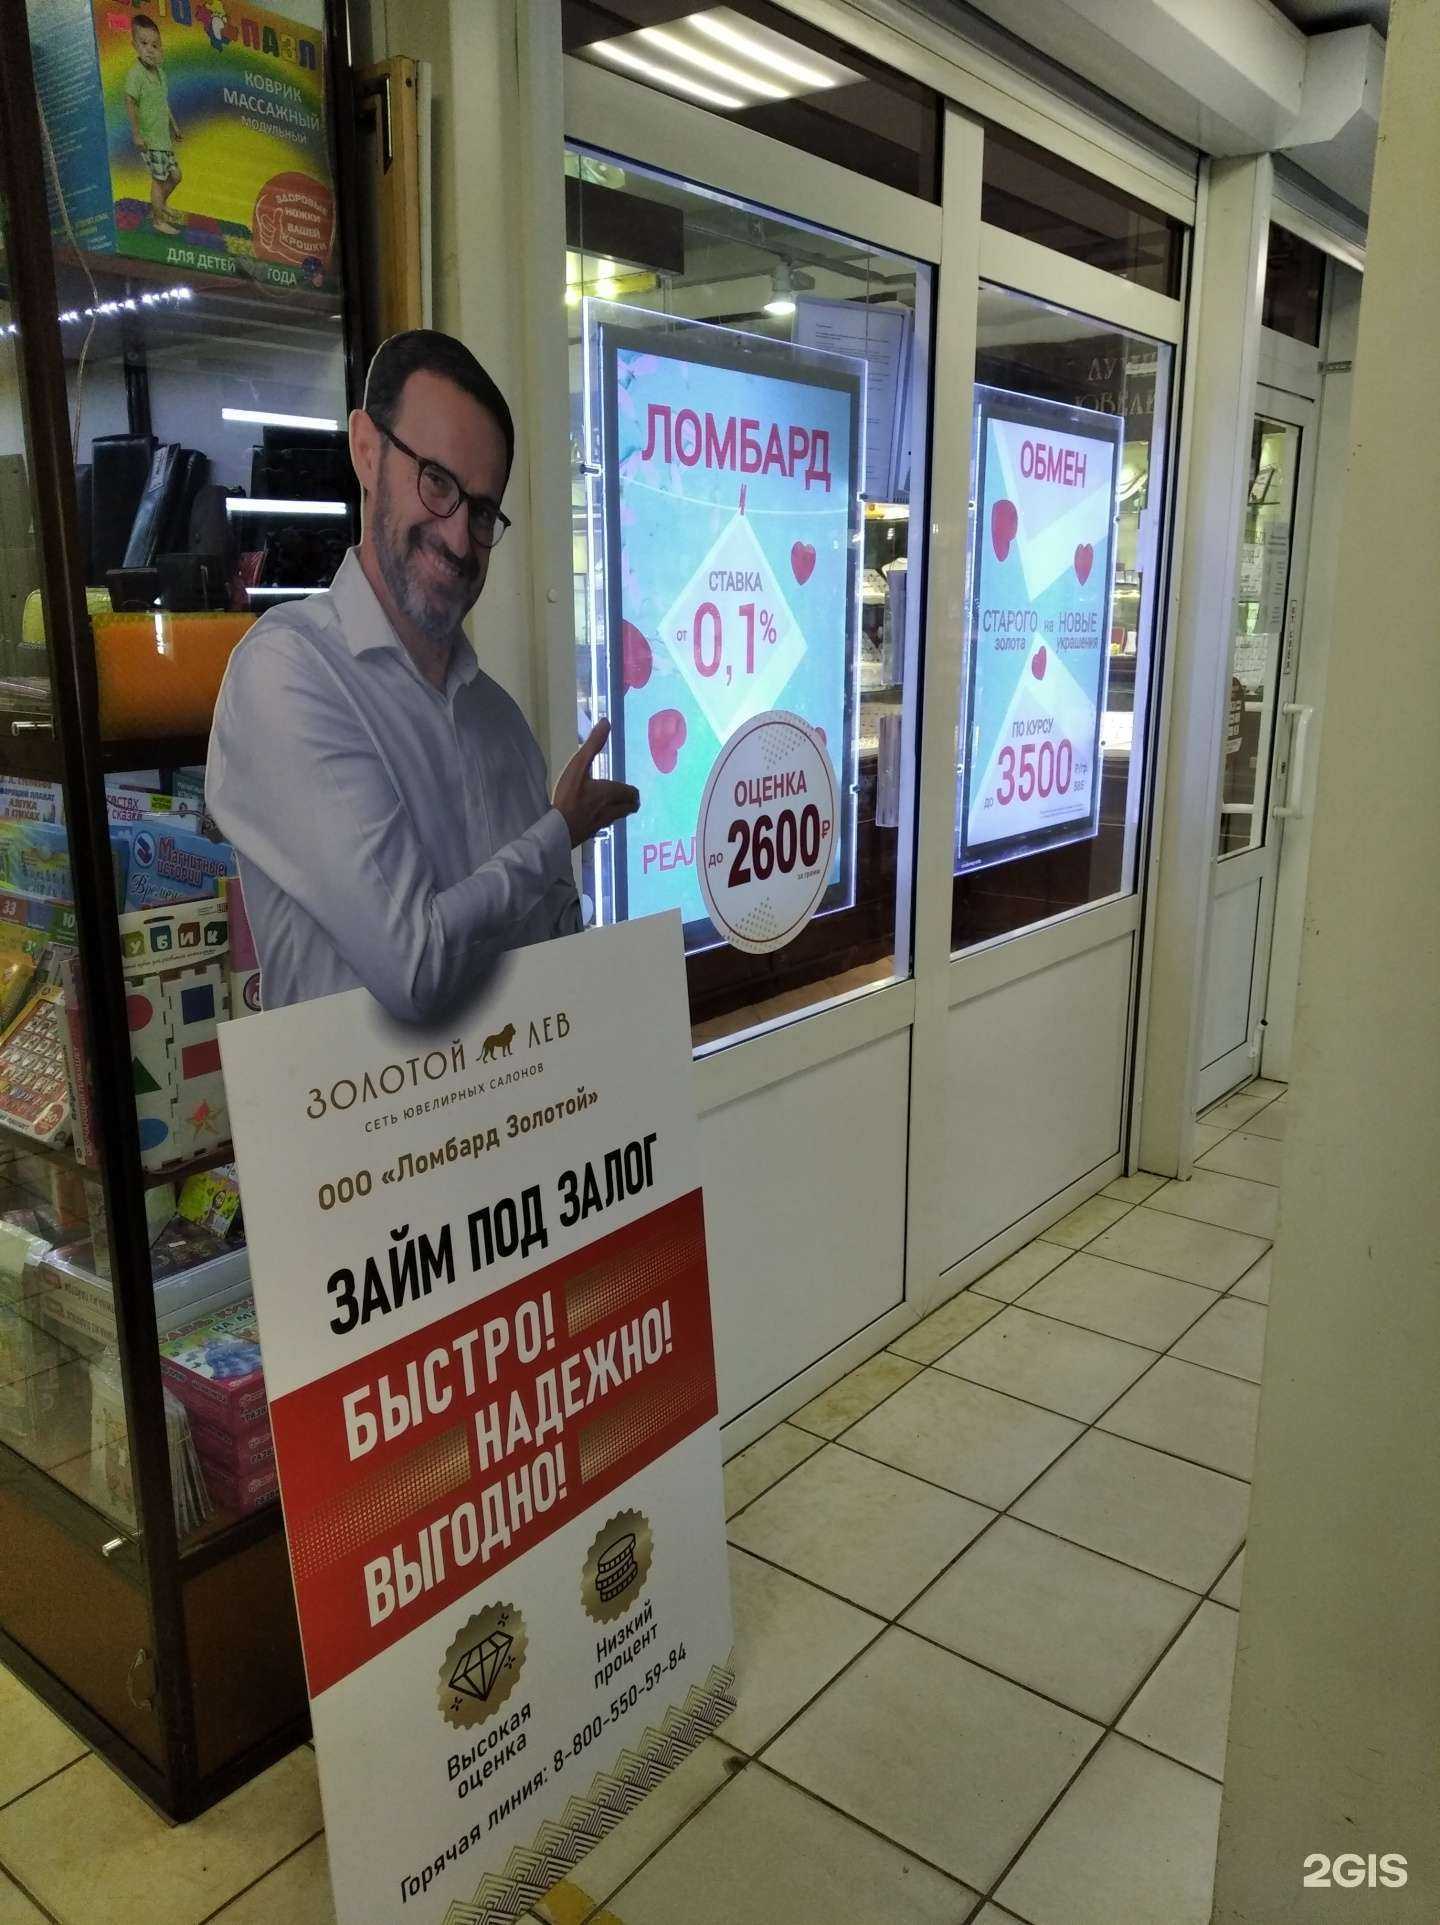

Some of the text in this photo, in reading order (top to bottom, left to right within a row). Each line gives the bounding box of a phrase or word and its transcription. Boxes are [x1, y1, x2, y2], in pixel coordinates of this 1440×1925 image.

[223, 87, 321, 132] МАССАЖНЫЙ
[244, 70, 303, 104] КОВРИК
[240, 115, 308, 145] МОДУЛЬНЫЙ
[167, 247, 197, 265] ДЛЯ
[197, 250, 237, 273] ДЕТЕЙ
[641, 403, 832, 493] ЛОМБАРД
[1020, 440, 1087, 488] ОБМЕН
[708, 571, 763, 593] СТАВКА
[693, 602, 777, 686] 0,1%
[982, 609, 1038, 633] СТАРОГО
[1058, 611, 1098, 633] НОВЫЕ
[1012, 718, 1055, 738] ПО КУРСУ
[734, 769, 807, 809] ОЦЕНКА
[996, 738, 1073, 806] 3500
[306, 1013, 570, 1119] ЗОЛОТОЙ ЛЕВ
[364, 1062, 544, 1133] СЕТЬ ЮВЕЛИРНЫХ САЛОНОВ
[317, 1085, 599, 1211] ООО «Ломбард Золотой»
[326, 1133, 657, 1336] ЗАЙМ ПОД ЗАЛОГ
[342, 1290, 556, 1462] БЫСТРО!
[475, 1300, 673, 1472] НАДЕЖНО!
[363, 1442, 569, 1628] ВЫГОДНО!
[593, 1623, 659, 1690] процент
[596, 1599, 653, 1663] Низкий
[401, 1641, 687, 1904] Горячая линия: 8-800-550-59-84
[447, 1703, 532, 1782] Высокая
[457, 1733, 527, 1799] оценка
